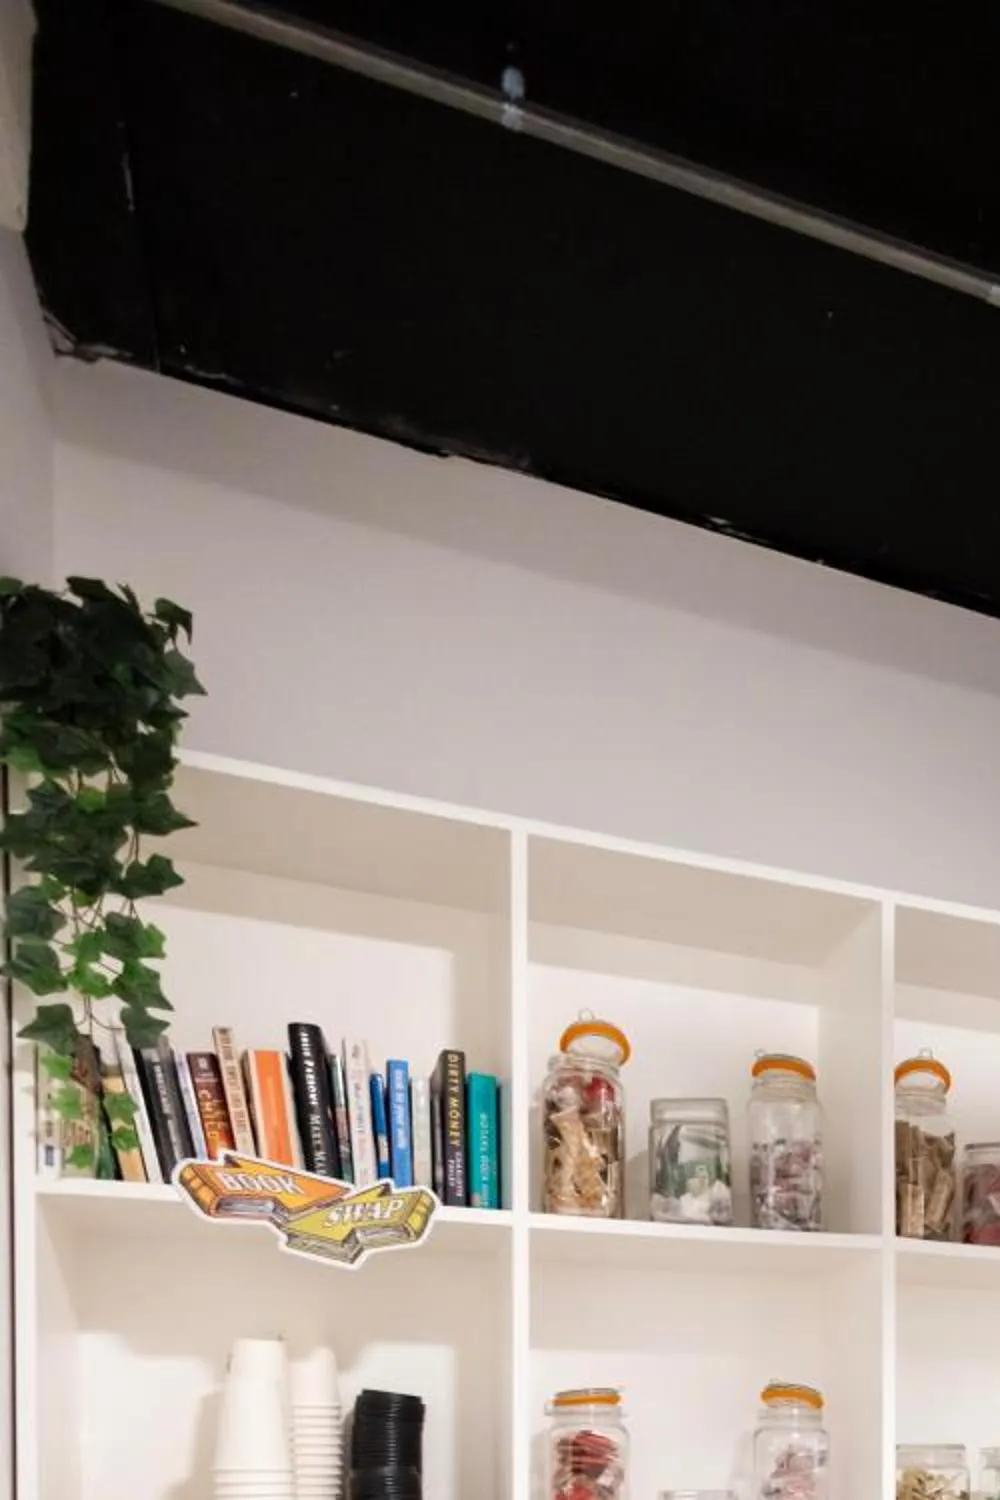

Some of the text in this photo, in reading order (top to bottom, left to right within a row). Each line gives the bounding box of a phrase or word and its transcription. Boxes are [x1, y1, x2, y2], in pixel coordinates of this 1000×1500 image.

[448, 1053, 462, 1147] DIRTY MONEY
[218, 1171, 304, 1195] BOOK
[323, 1199, 404, 1228] SWAP
